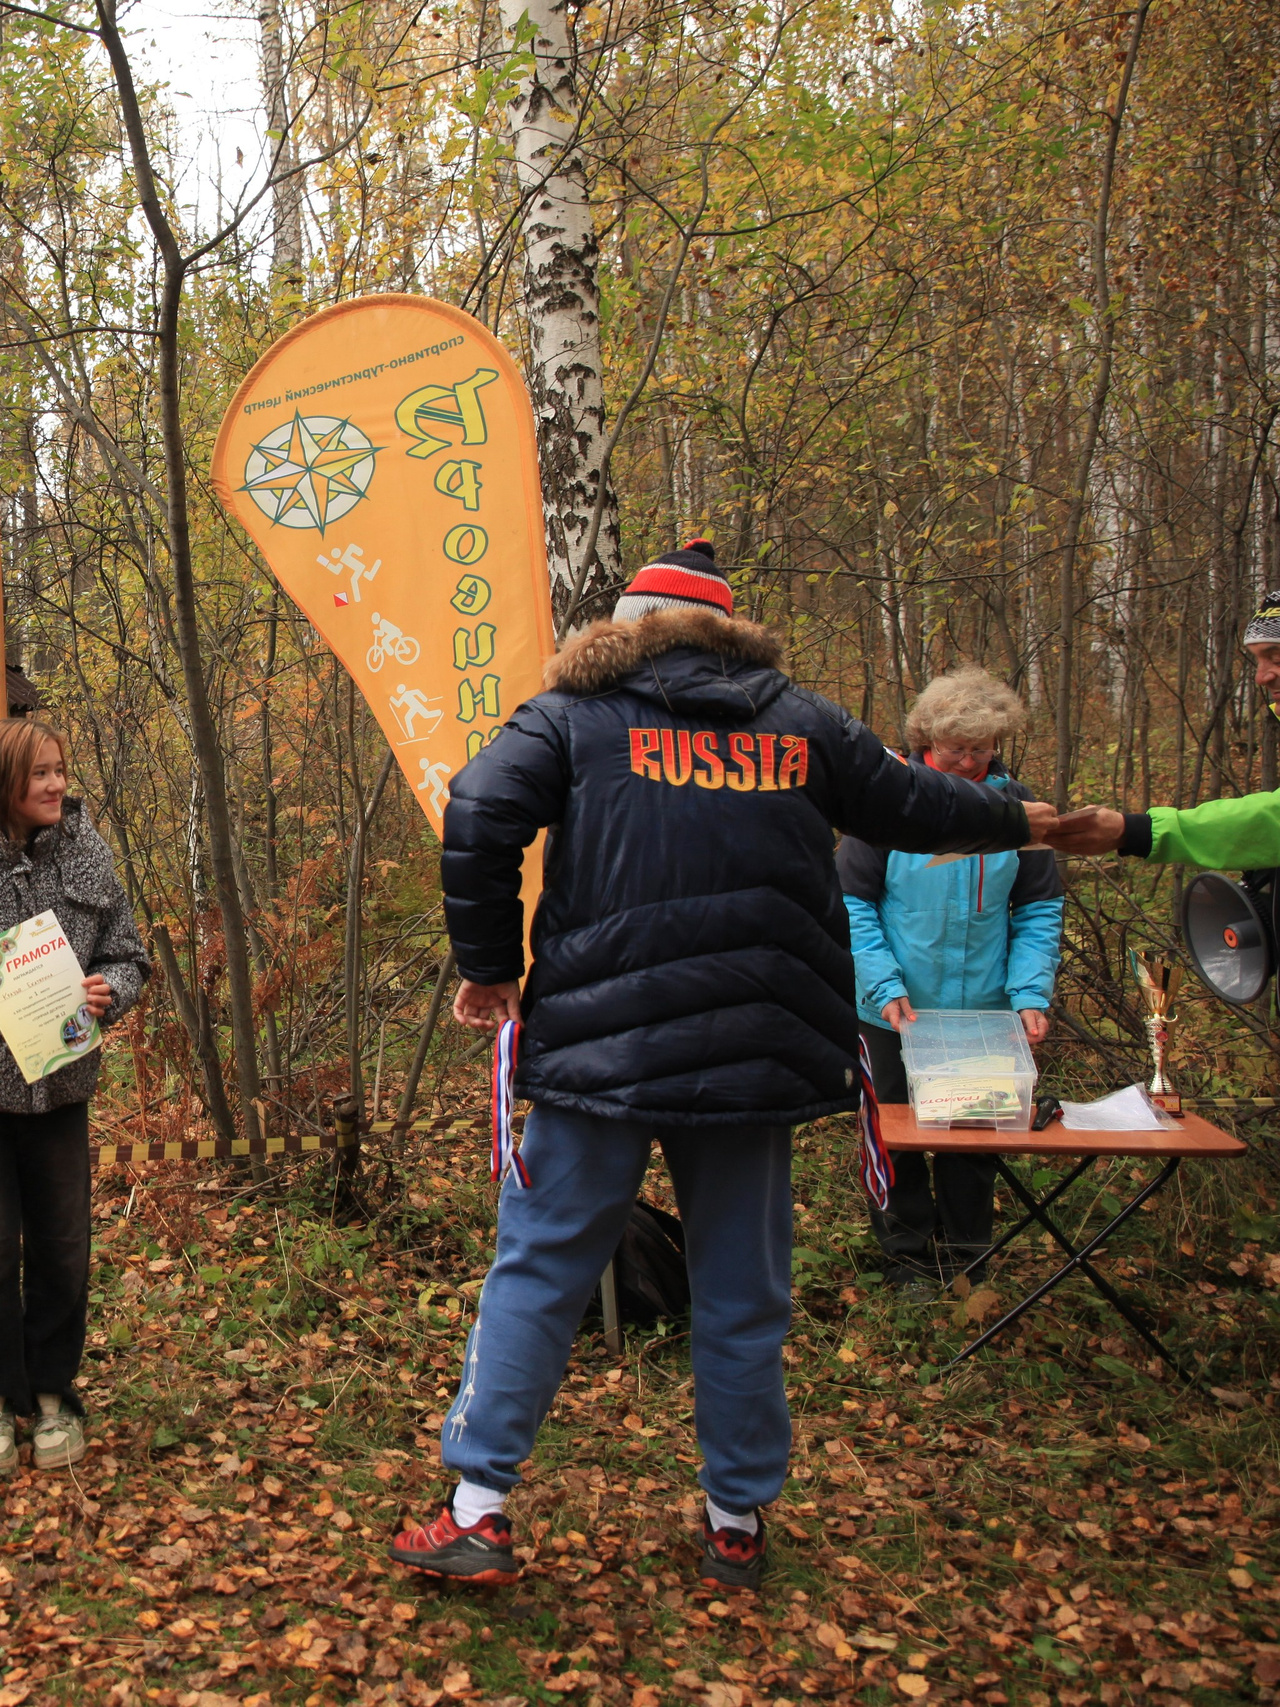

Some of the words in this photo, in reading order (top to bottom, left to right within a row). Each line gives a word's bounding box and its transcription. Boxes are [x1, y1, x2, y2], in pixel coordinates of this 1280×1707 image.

[628, 728, 809, 792] RUSSIA
[6, 936, 66, 973] ГРАМОТА
[920, 1095, 980, 1105] ГРАМОТА
